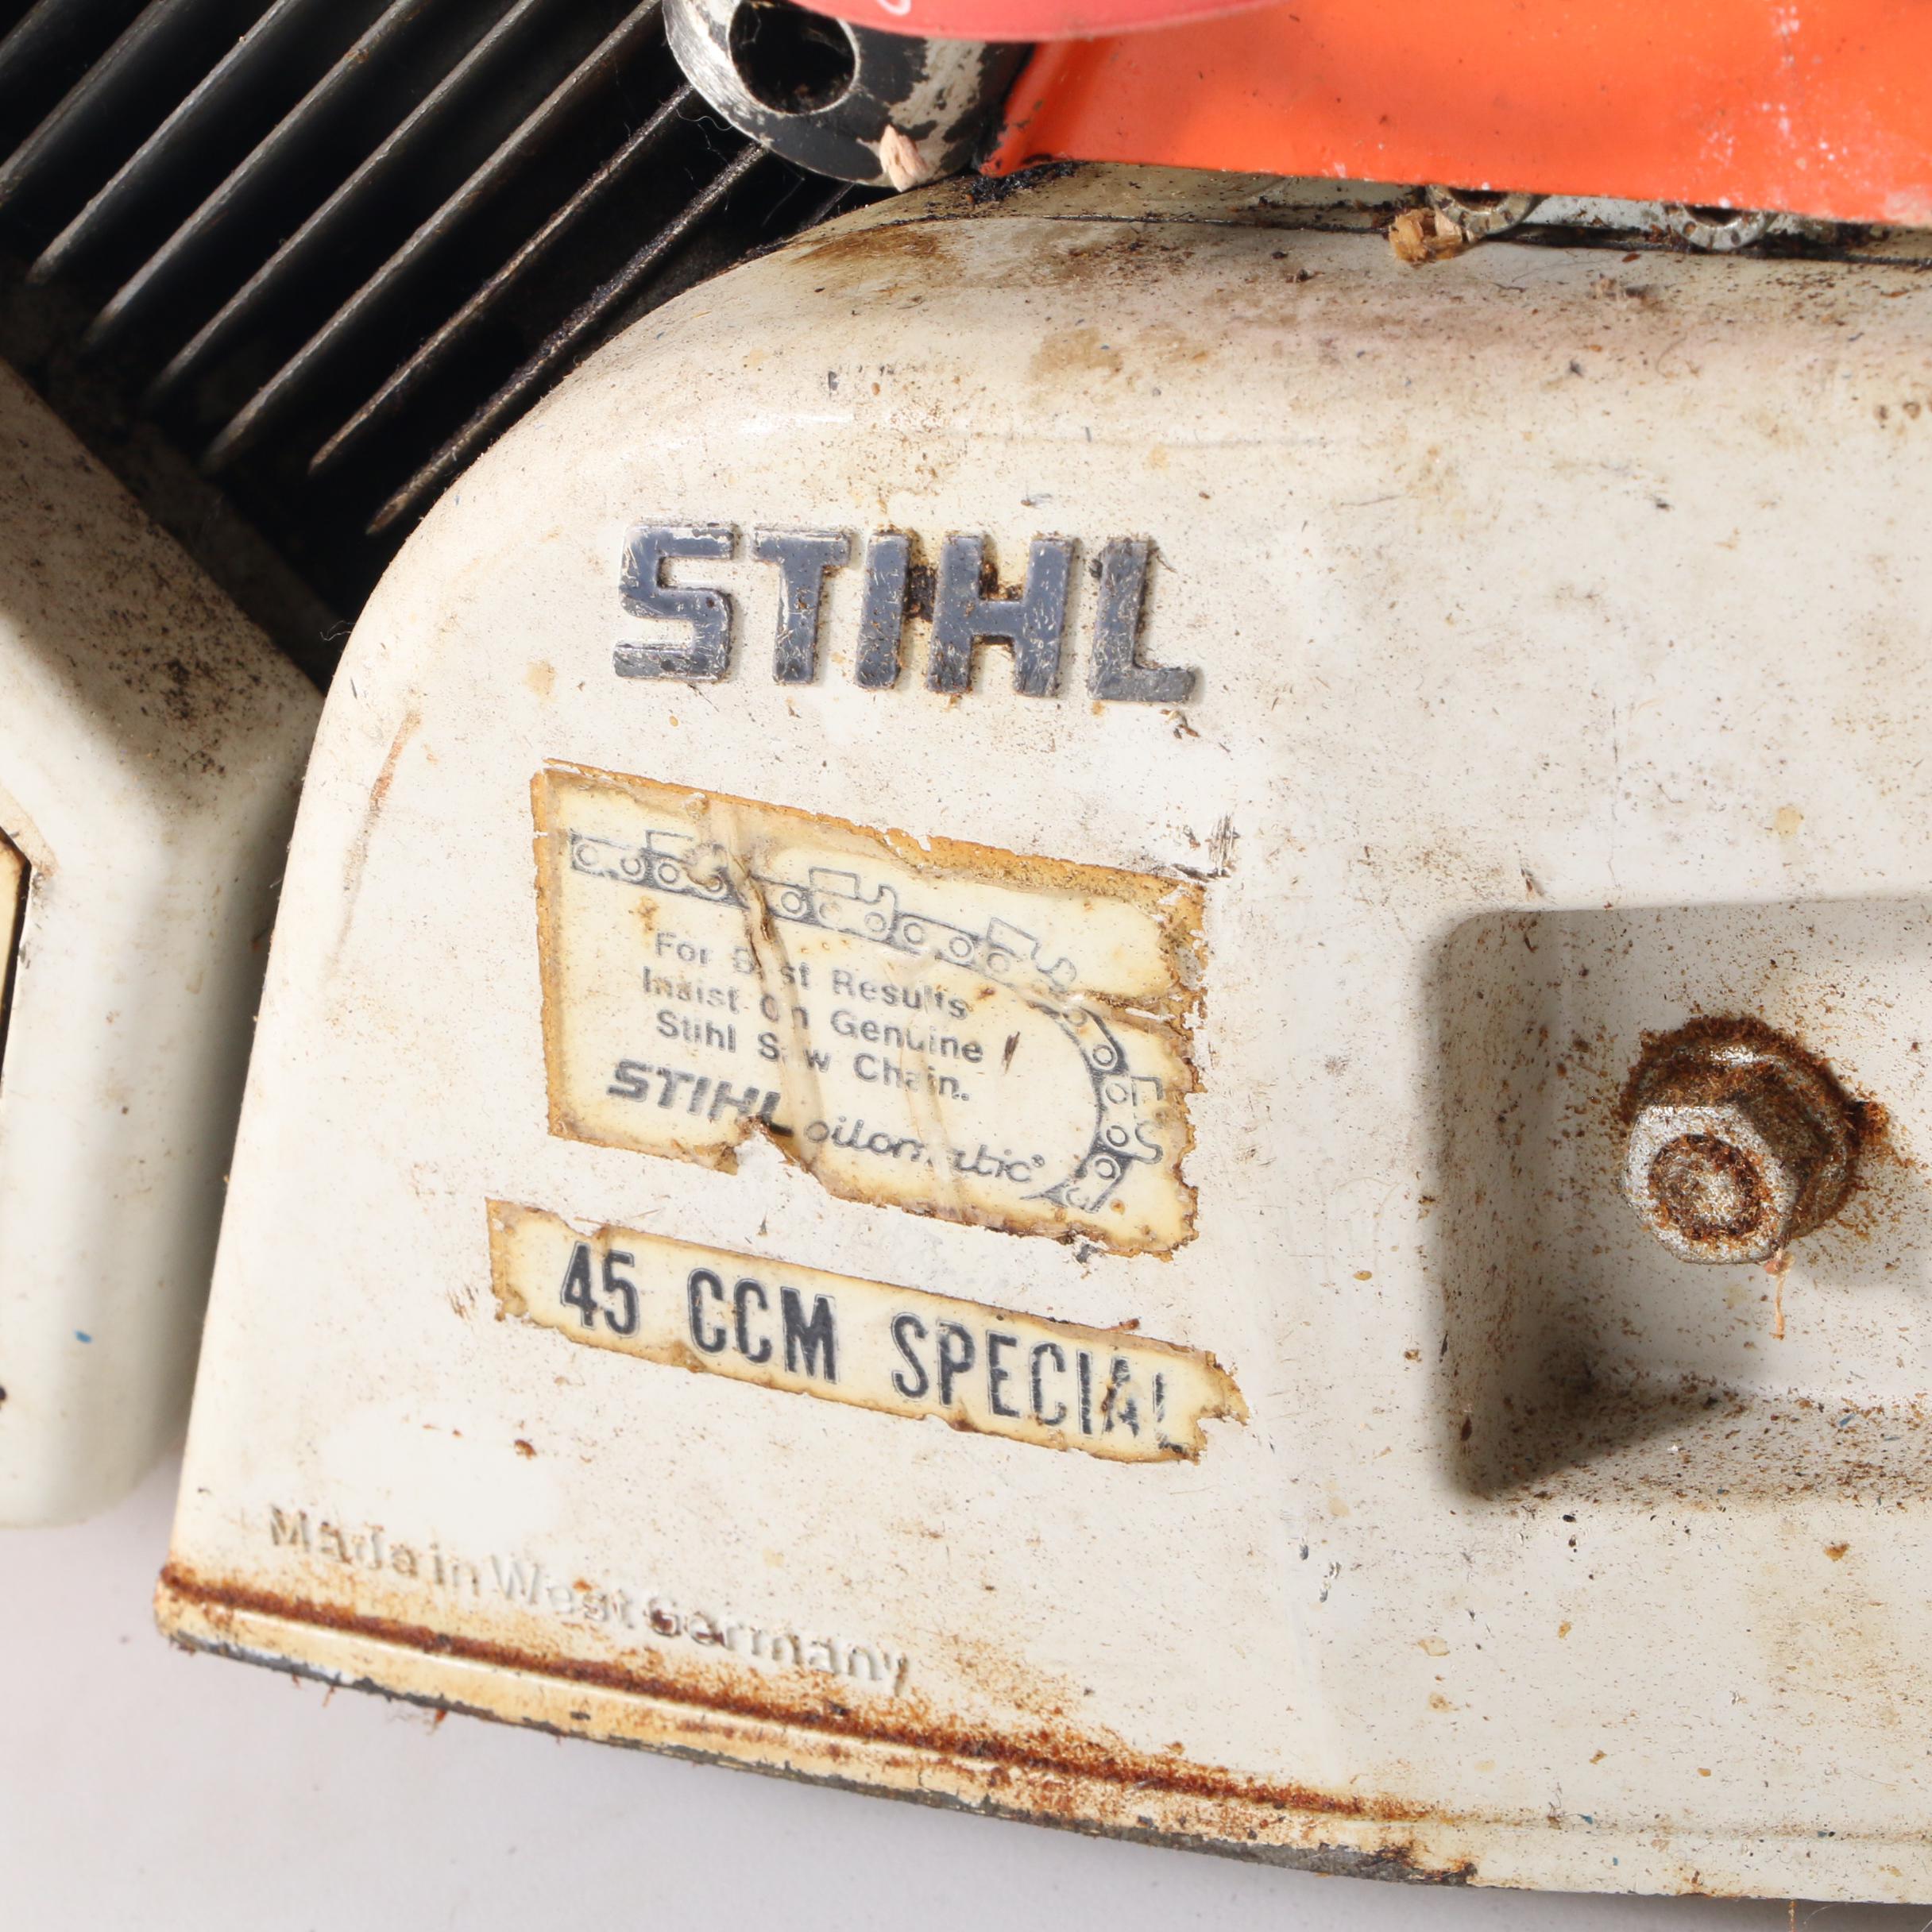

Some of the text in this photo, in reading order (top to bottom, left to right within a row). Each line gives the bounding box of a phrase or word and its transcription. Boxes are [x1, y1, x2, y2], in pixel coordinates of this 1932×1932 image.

[612, 525, 1197, 703] STIHL
[643, 965, 983, 1064] Insist On Genuine
[655, 932, 968, 1020] For Bst Results
[656, 1009, 736, 1053] Stihl
[757, 1032, 830, 1072] Sw
[606, 1059, 794, 1138] STIHL
[560, 1240, 638, 1338] 45
[686, 1266, 839, 1384] CCM
[430, 1540, 480, 1598] in
[488, 1553, 636, 1630] West
[643, 1594, 910, 1698] Germany
